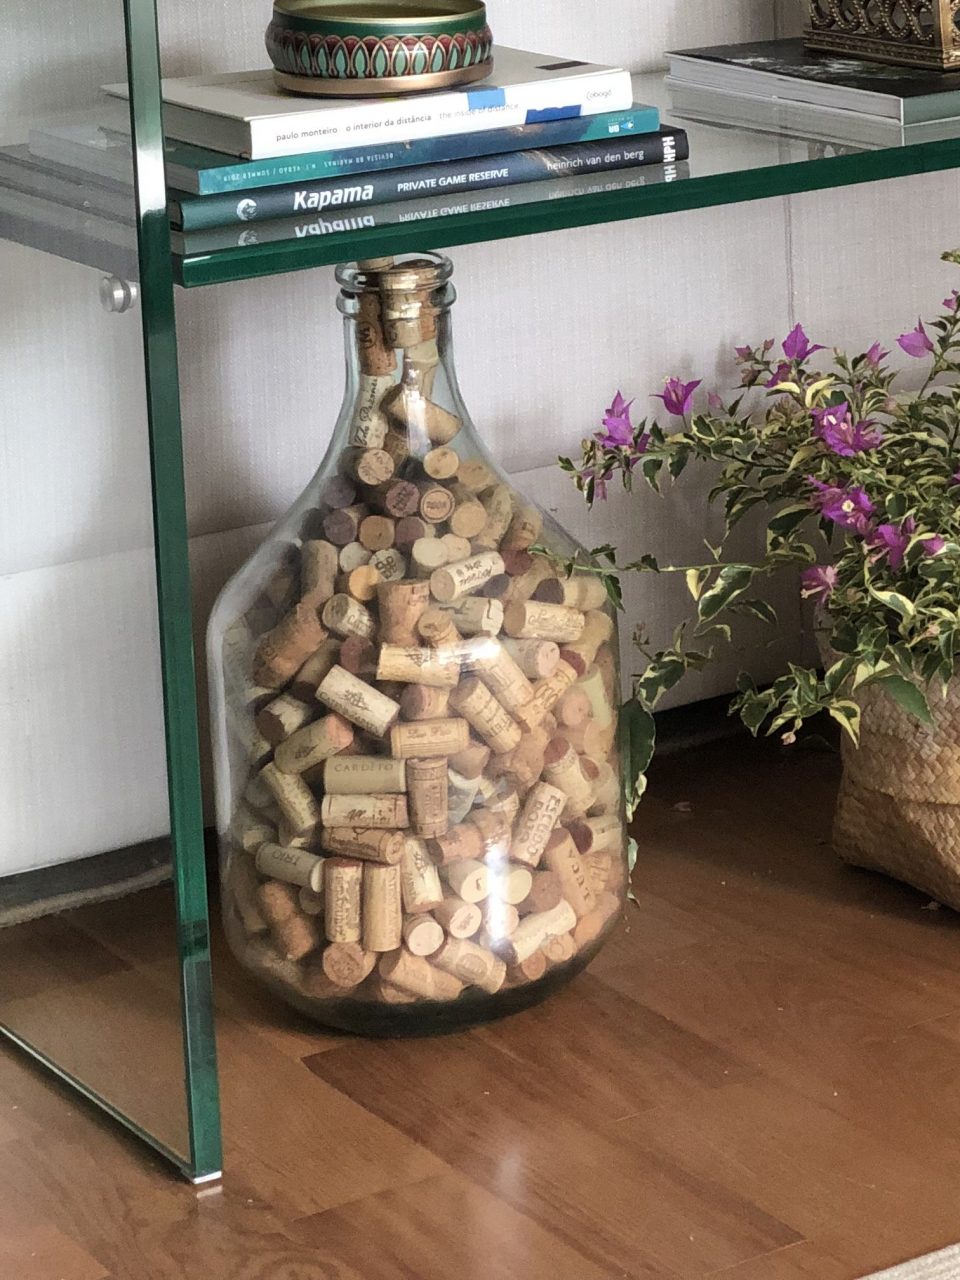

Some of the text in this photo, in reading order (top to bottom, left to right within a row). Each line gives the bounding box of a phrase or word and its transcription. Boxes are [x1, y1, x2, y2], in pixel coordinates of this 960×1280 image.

[276, 131, 299, 142] paulo
[301, 126, 338, 138] monteiro
[353, 121, 382, 132] interior
[384, 118, 395, 127] da
[396, 114, 432, 125] distância
[293, 150, 645, 212] Kapama PRIVATE GAME RESERVE heinrich van den berg
